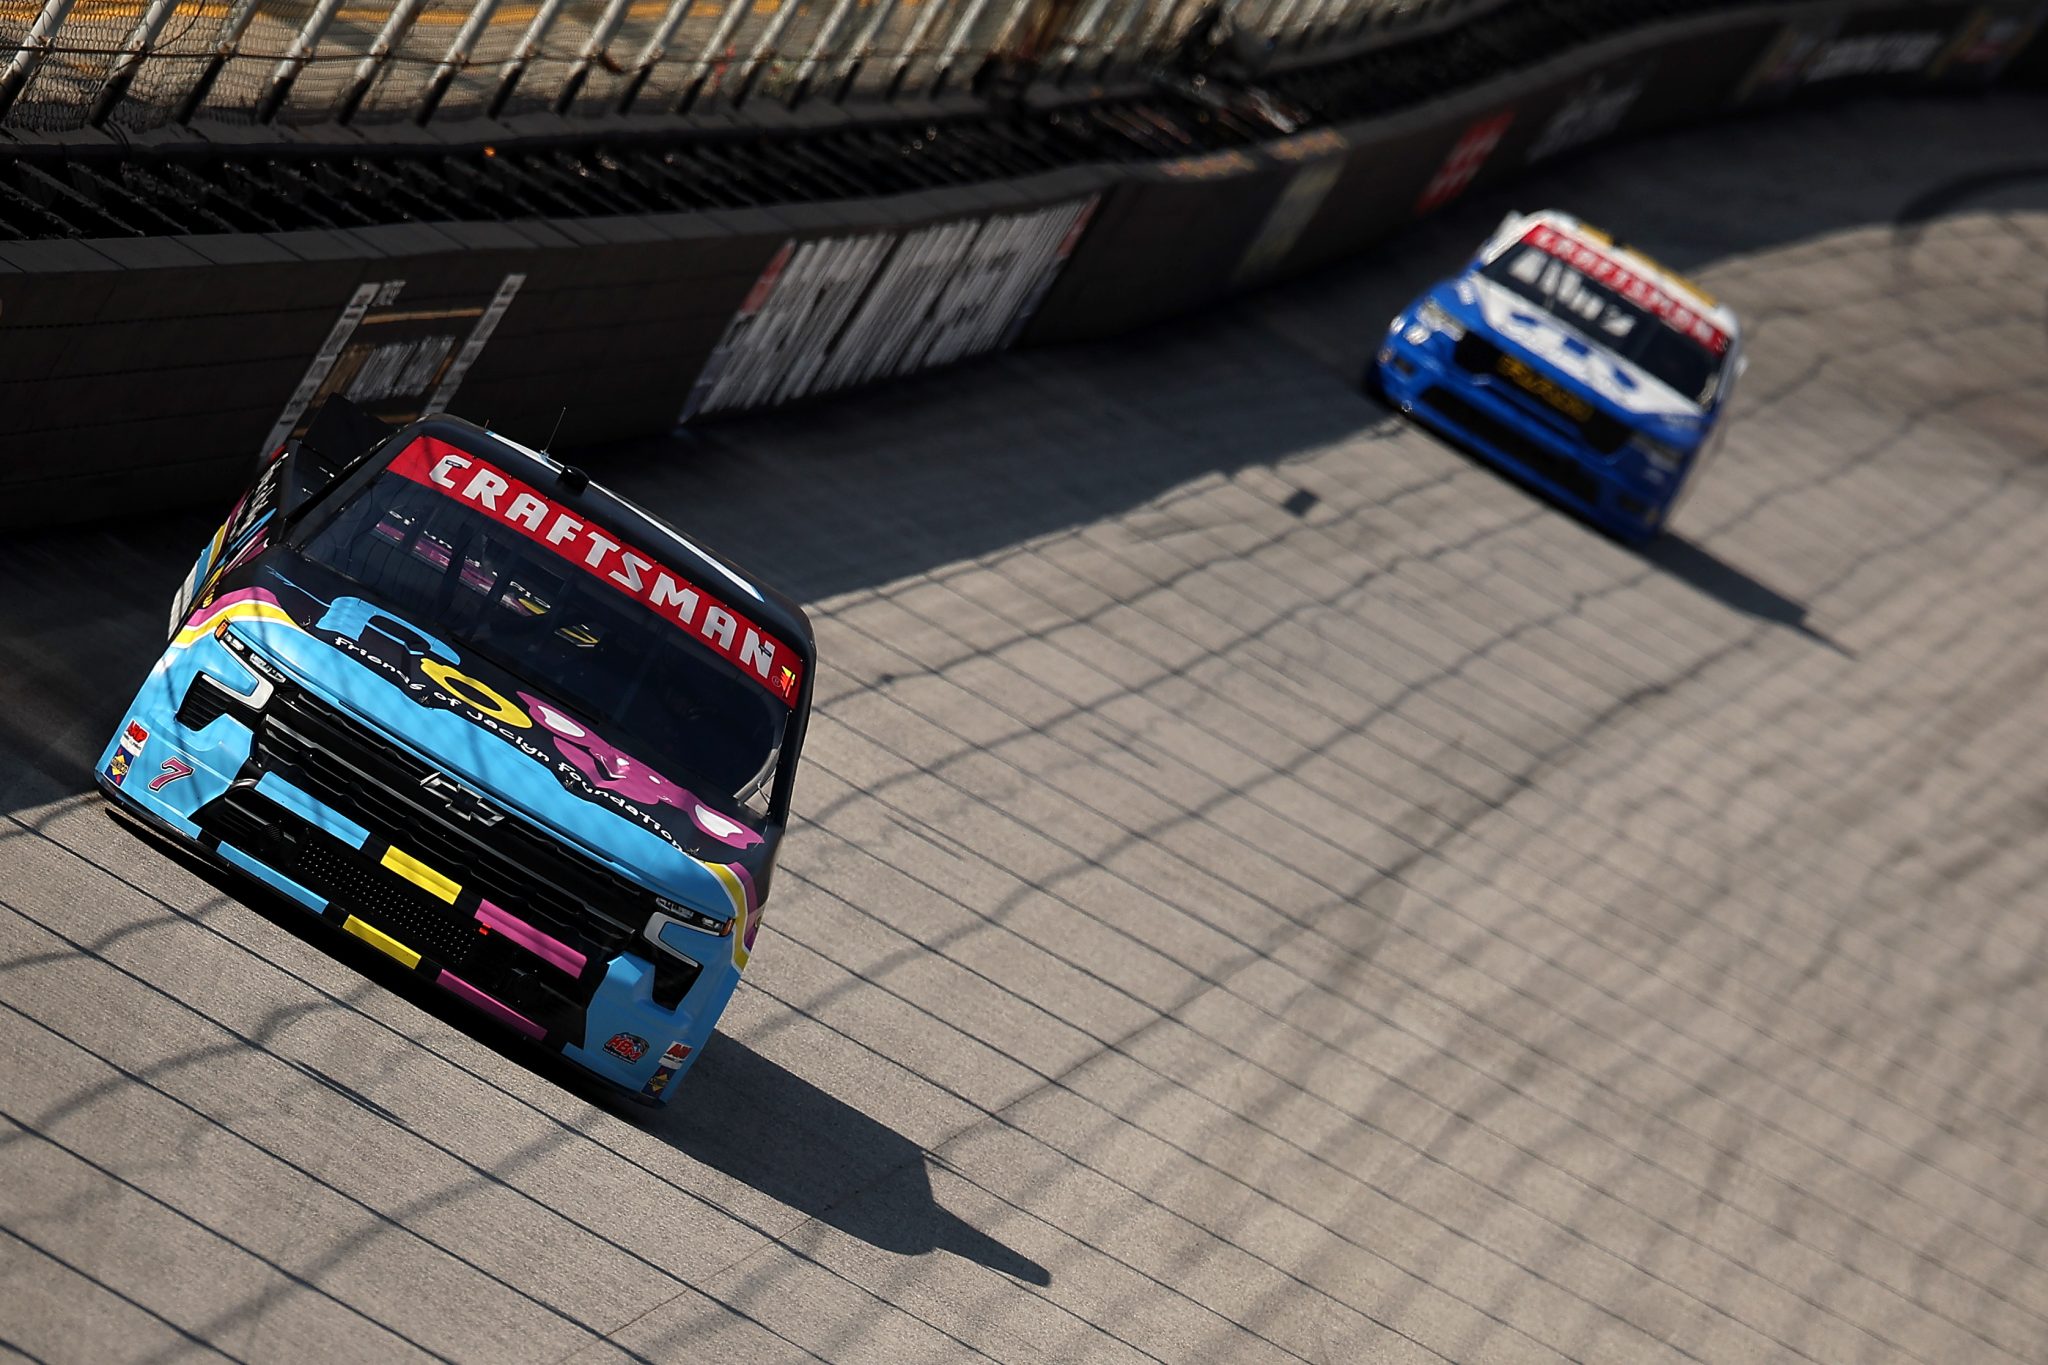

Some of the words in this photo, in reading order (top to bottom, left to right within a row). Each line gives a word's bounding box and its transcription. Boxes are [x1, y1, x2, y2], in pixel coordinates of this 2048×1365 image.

[428, 454, 776, 679] CRAFTSMAN
[149, 757, 194, 792] 7
[334, 636, 425, 691] Friends
[434, 692, 463, 708] of
[466, 711, 549, 763] Jaclyn
[558, 761, 686, 852] Foundation
